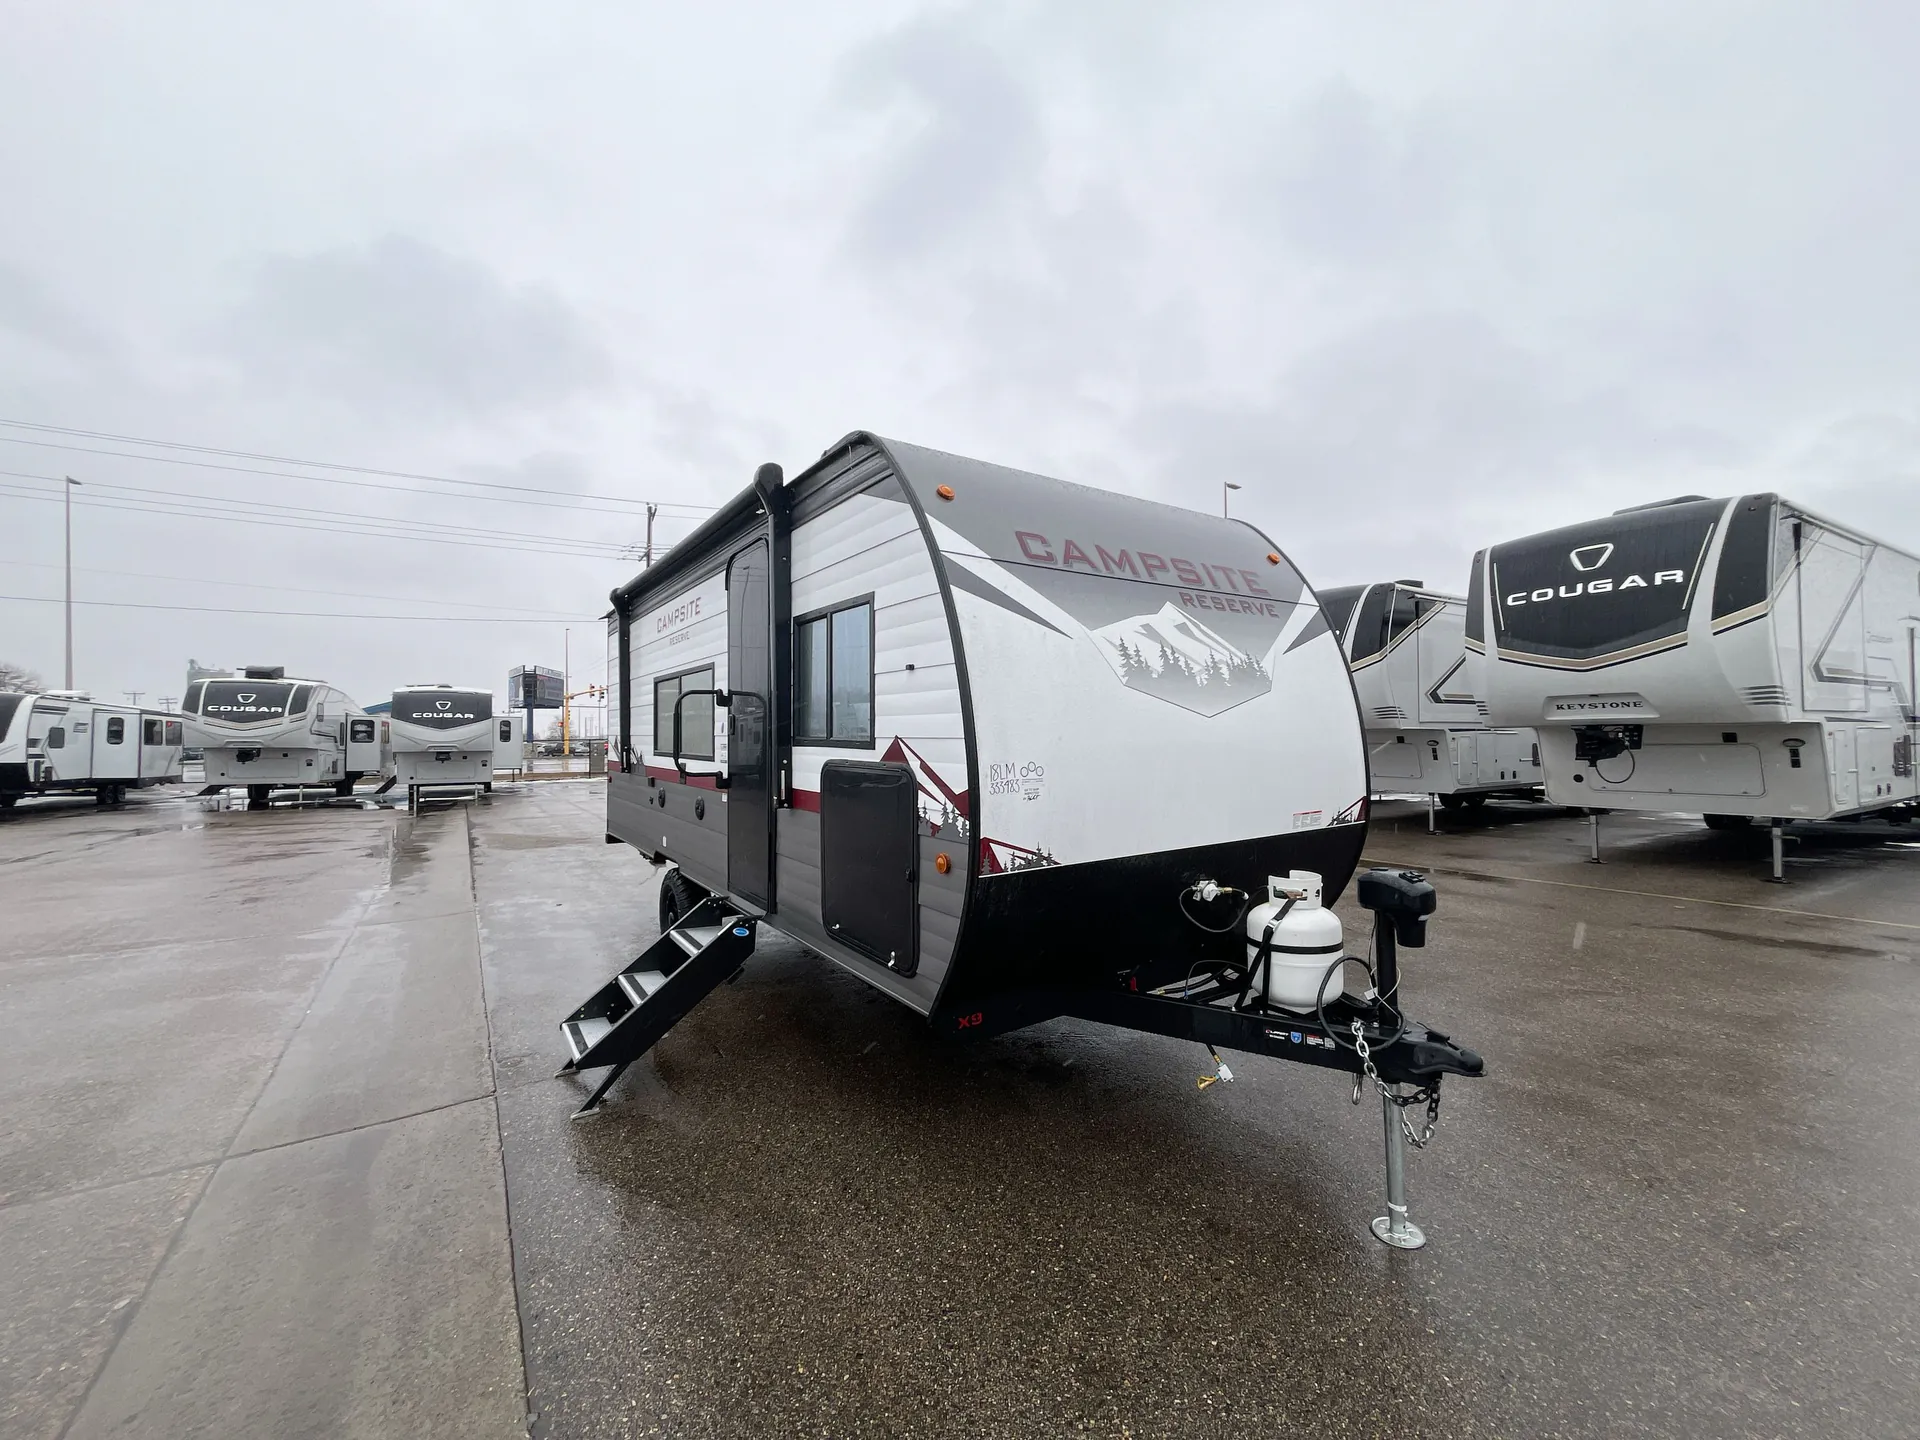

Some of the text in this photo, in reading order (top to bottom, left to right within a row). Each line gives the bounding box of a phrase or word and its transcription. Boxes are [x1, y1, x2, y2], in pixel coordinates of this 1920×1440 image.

[1014, 530, 1272, 594] CAMPSITE
[1506, 569, 1684, 606] COUGAR
[656, 596, 702, 634] CAMPSITE
[1178, 591, 1280, 619] RESERVE
[207, 705, 283, 713] COUGAR
[1555, 701, 1644, 711] KEYSTONE
